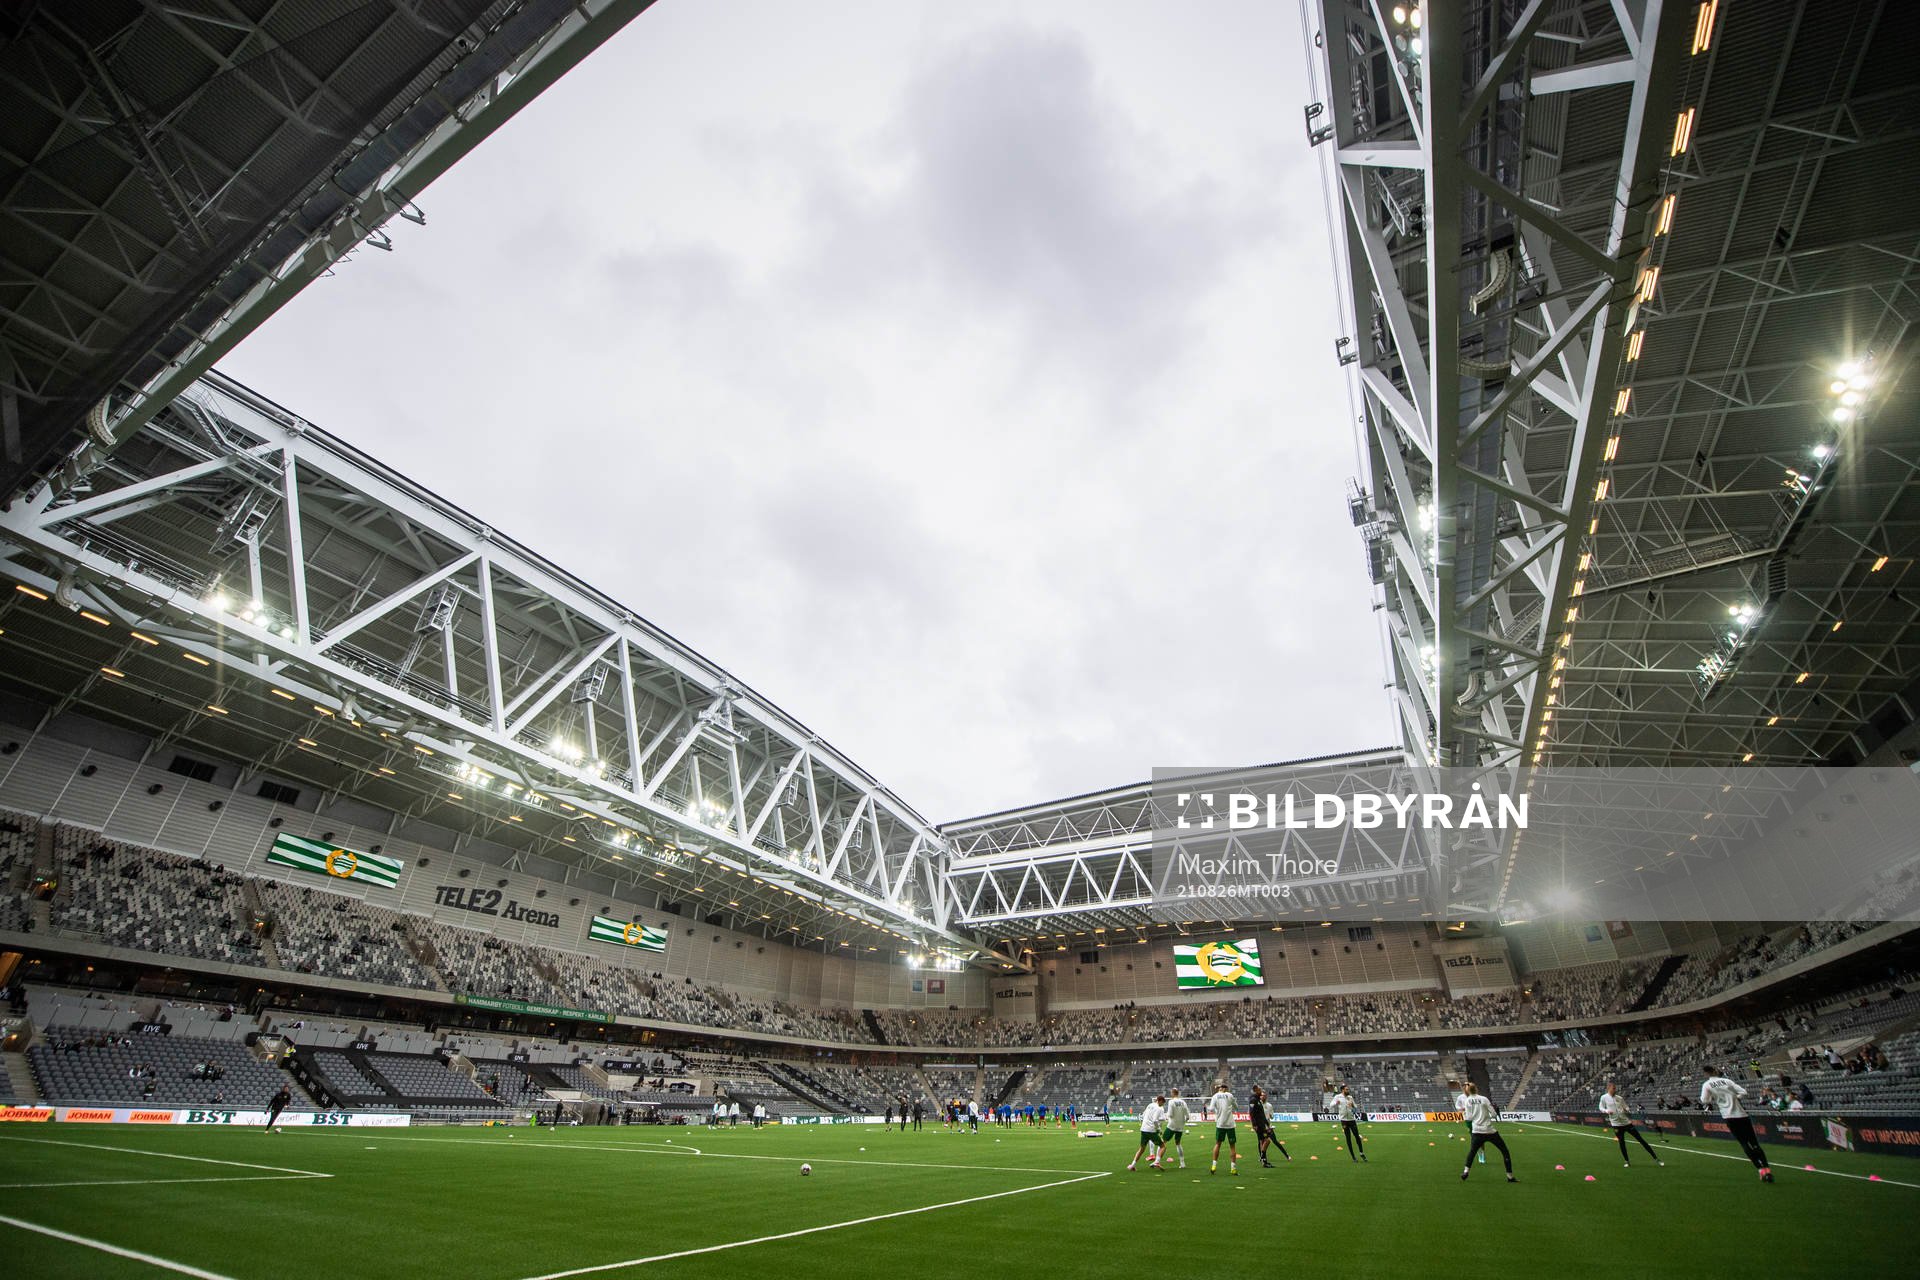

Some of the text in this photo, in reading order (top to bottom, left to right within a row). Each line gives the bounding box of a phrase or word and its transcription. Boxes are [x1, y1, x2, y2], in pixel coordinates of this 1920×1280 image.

[435, 886, 560, 928] TELE2 Arena
[1445, 955, 1504, 967] TELE2 Arena
[1, 1110, 48, 1119] JOBMAN
[68, 1112, 112, 1120] JOBMAN
[131, 1113, 171, 1121] JOBMAN
[187, 1110, 236, 1124] BST
[312, 1112, 352, 1125] BST
[1376, 1113, 1423, 1121] INTERSPORT
[1432, 1112, 1465, 1121] JOBM
